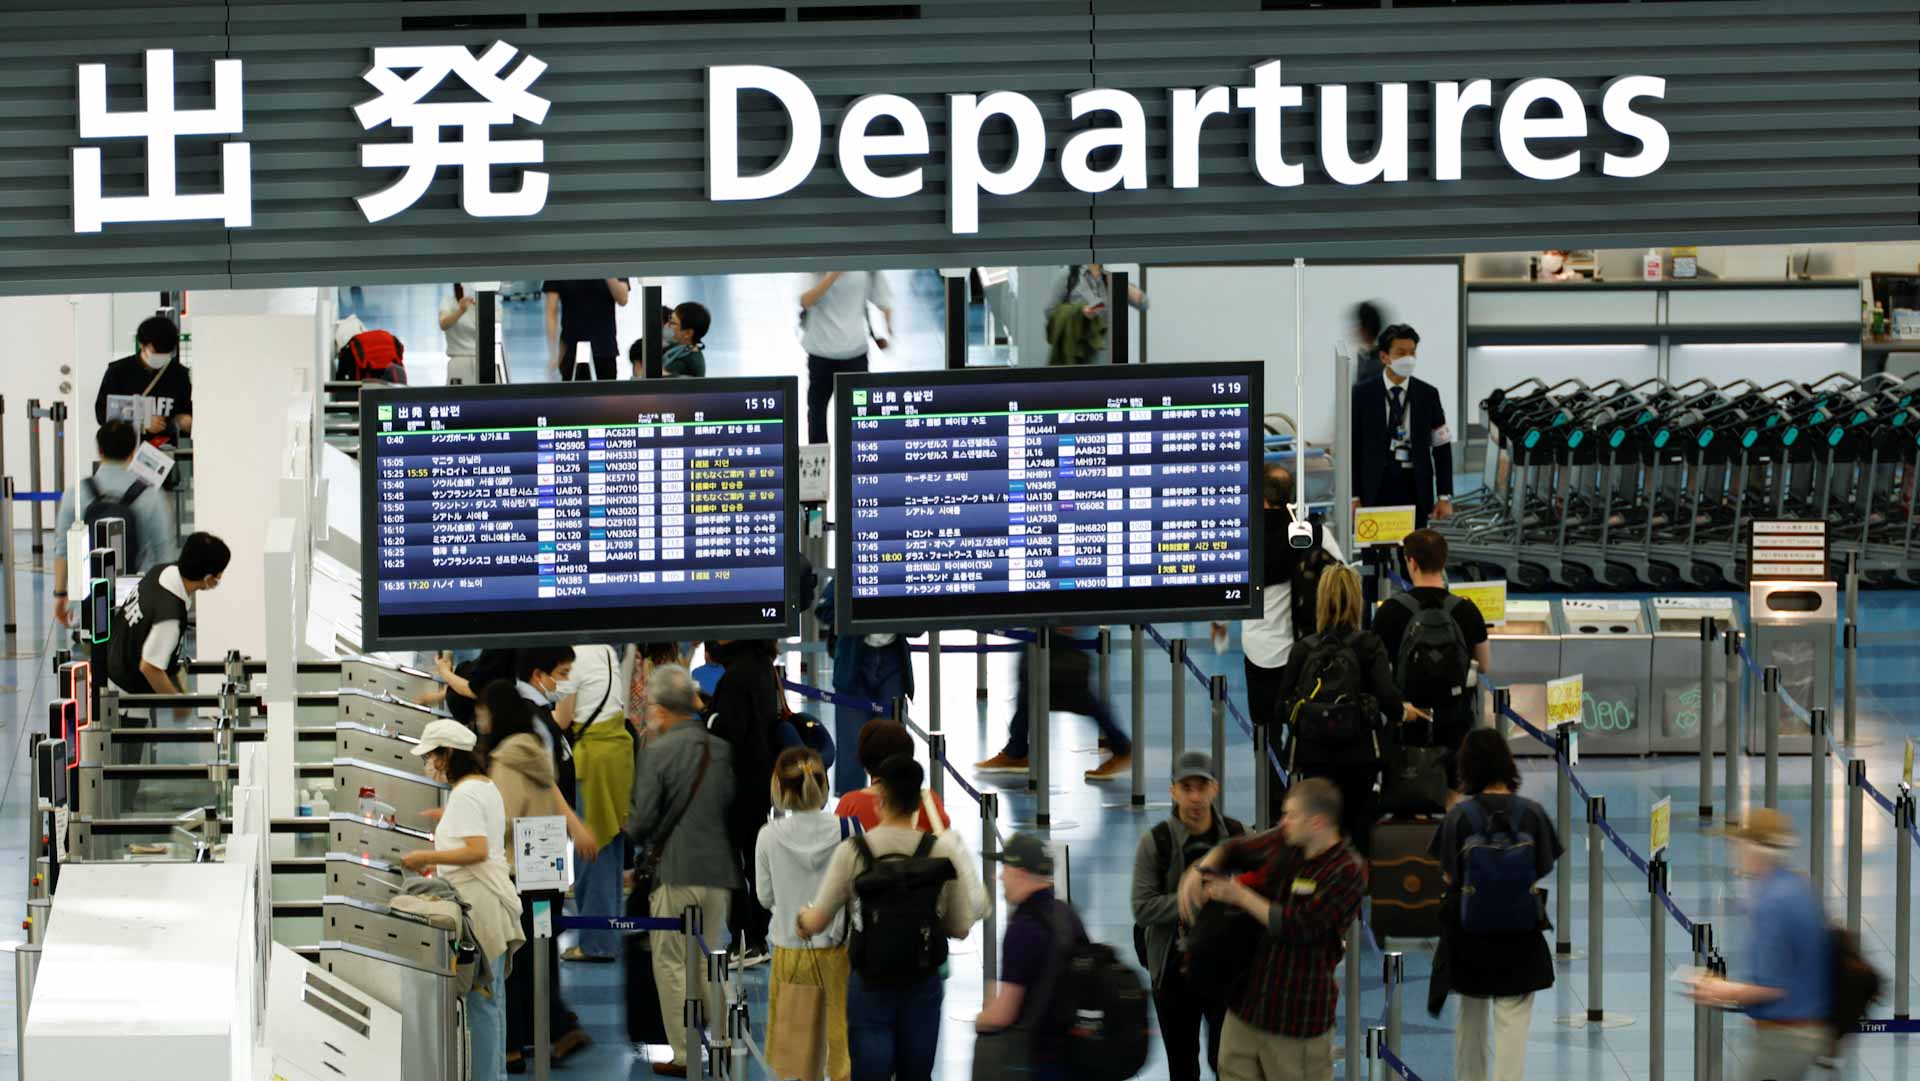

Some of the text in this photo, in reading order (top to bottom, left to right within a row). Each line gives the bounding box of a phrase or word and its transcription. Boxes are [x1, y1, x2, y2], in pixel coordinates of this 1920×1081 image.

[708, 61, 1669, 234] Departures
[1212, 382, 1241, 394] 15 19
[746, 398, 775, 410] 15 19
[857, 419, 878, 429] 16:40
[1026, 413, 1043, 424] JL25
[386, 435, 404, 444] 0:40
[556, 429, 582, 439] NH843
[606, 427, 636, 437] AC6228
[1026, 426, 1056, 434] MU4441
[555, 439, 636, 451] SQ5905 UA7991
[858, 442, 878, 451] 16:45
[905, 440, 948, 450] ロサンゼルス
[383, 458, 404, 467] 15:05
[432, 456, 454, 465] マニラ
[556, 452, 579, 461] PR421
[857, 453, 878, 462] 17:00
[905, 451, 948, 461] ロサンゼルス
[1026, 448, 1043, 457] JL16
[1076, 457, 1106, 466] MH9172
[383, 469, 404, 478] 15:25
[407, 469, 428, 477] 15:55
[432, 467, 468, 476] デトロイト
[556, 464, 580, 473] DL276
[606, 462, 637, 471] VN3030
[858, 476, 878, 484] 17:10
[1076, 468, 1106, 477] UA7973
[383, 480, 404, 490] 15:40
[556, 475, 573, 484] JL93
[605, 473, 635, 482] KE5710
[1026, 481, 1056, 490] VN3495
[383, 492, 404, 501] 15:45
[432, 488, 490, 499] サンフランシスコ
[556, 486, 582, 495] UA876
[605, 484, 637, 494] NH7010
[858, 498, 878, 507] 17:15
[1026, 492, 1052, 501] UA130
[1076, 490, 1106, 499] NH7544
[384, 503, 404, 512] 15:50
[556, 497, 582, 506] UA804
[605, 496, 637, 505] NH7028
[858, 509, 878, 518] 17:25
[906, 507, 934, 516] シアトル
[1075, 501, 1104, 510] TG6082
[384, 514, 404, 523] 16:05
[432, 512, 462, 521] シアトル
[556, 509, 581, 518] DL166
[606, 506, 637, 516] VN3020
[1026, 514, 1057, 523] UA7930
[384, 525, 404, 534] 16:10
[606, 518, 636, 527] OZ9103
[858, 531, 878, 540] 17:40
[906, 529, 933, 538] トロント
[1026, 526, 1042, 534] AC2
[1076, 523, 1106, 533] NH6820
[384, 537, 405, 546] 16:20
[556, 531, 581, 540] DL120
[606, 529, 637, 538] VN3026
[858, 542, 878, 551] 17:45
[1076, 534, 1106, 544] NH7006
[384, 548, 404, 557] 16:25
[605, 540, 633, 550] JL7039
[858, 554, 878, 562] 18:15
[882, 553, 902, 562] 18:00
[1026, 548, 1052, 556] AA176
[1075, 546, 1101, 555] JL7014
[384, 559, 404, 568] 16:25
[433, 556, 491, 566] サンフランシスコ
[556, 554, 568, 562] JL2
[556, 564, 587, 574] MH9102
[858, 564, 878, 573] 18:20
[1026, 559, 1043, 568] JL99
[384, 581, 405, 591] 16:35
[408, 581, 429, 590] 17:20
[433, 580, 454, 589] ハノイ
[606, 574, 638, 583] NH9713
[858, 576, 878, 585] 18:25
[858, 587, 878, 596] 18:25
[906, 584, 941, 594] アトランタ
[1026, 581, 1050, 590] DL296
[1075, 578, 1106, 588] VN3010
[557, 587, 586, 596] DL7474
[1226, 590, 1240, 600] 2/2
[762, 608, 776, 617] 1/2
